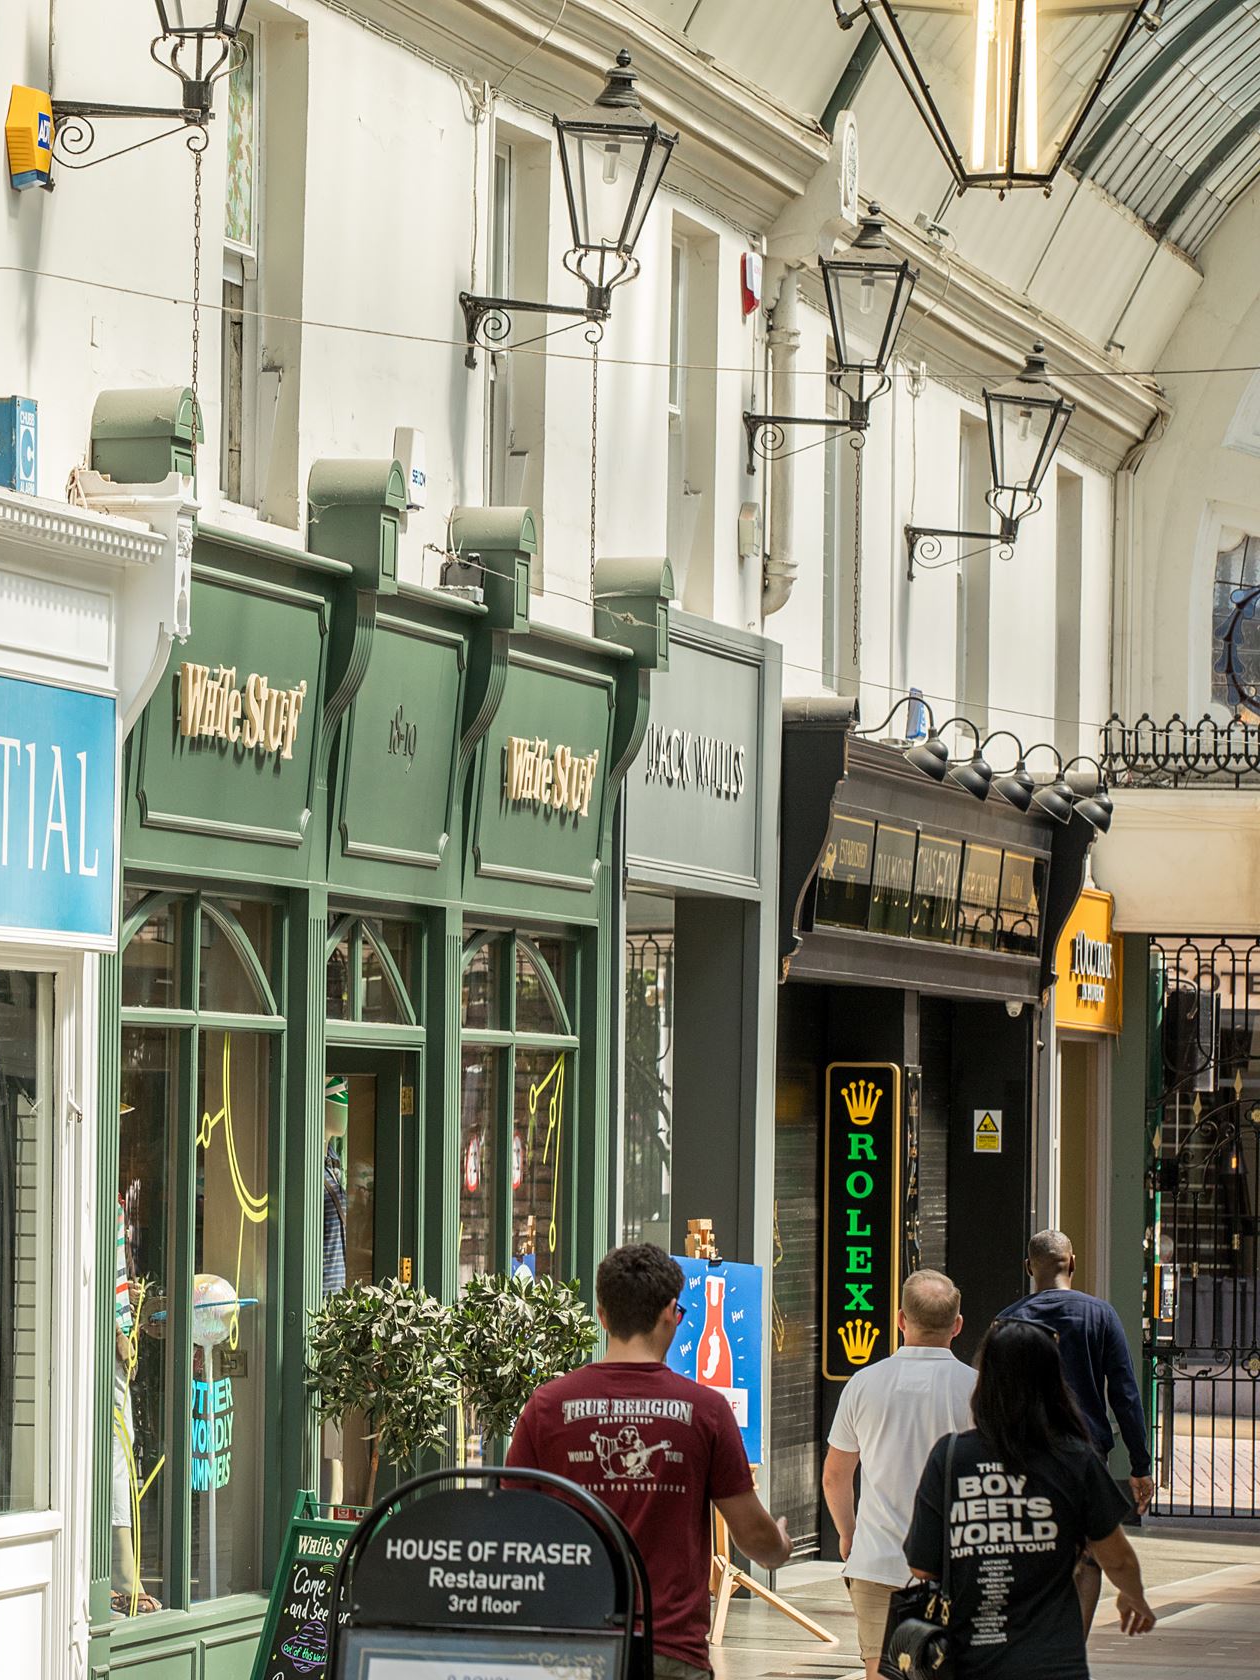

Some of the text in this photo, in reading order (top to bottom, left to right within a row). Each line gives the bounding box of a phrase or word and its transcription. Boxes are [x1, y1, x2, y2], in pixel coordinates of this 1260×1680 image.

[388, 704, 417, 774] 18-19
[647, 722, 745, 795] JACK WILLS
[839, 838, 868, 869] ESTABLISHED
[843, 1132, 878, 1312] ROLEX
[562, 1398, 693, 1426] TRUE RELIGION
[568, 1450, 684, 1463] WORLD TOUR
[976, 1462, 1005, 1473] THE
[192, 1452, 232, 1492] UMMERS
[957, 1474, 1027, 1499] BOY
[385, 1537, 464, 1562] HOUSE
[467, 1540, 498, 1564] OF
[502, 1542, 592, 1566] FRASER
[976, 1543, 1015, 1556] TOUR
[1016, 1541, 1057, 1554] TOUR
[293, 1566, 326, 1602] Come
[428, 1566, 546, 1592] Restaurant
[289, 1598, 311, 1621] and
[309, 1602, 330, 1622] See
[447, 1593, 522, 1614] 3rd floor
